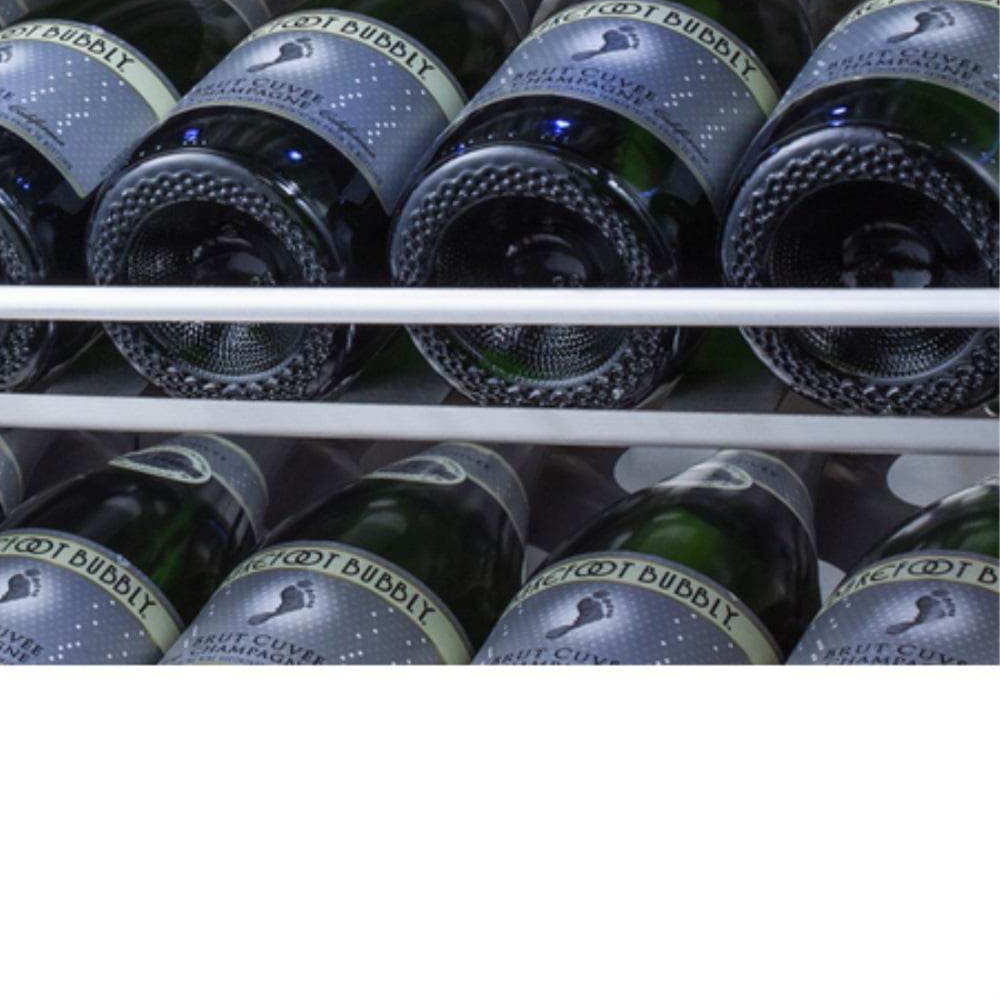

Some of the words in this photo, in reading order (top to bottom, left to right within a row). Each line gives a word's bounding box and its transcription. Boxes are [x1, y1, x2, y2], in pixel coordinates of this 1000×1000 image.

[68, 548, 157, 618] BUBBLY
[341, 558, 437, 625] BUBBLY
[637, 565, 742, 630] BUBBLY
